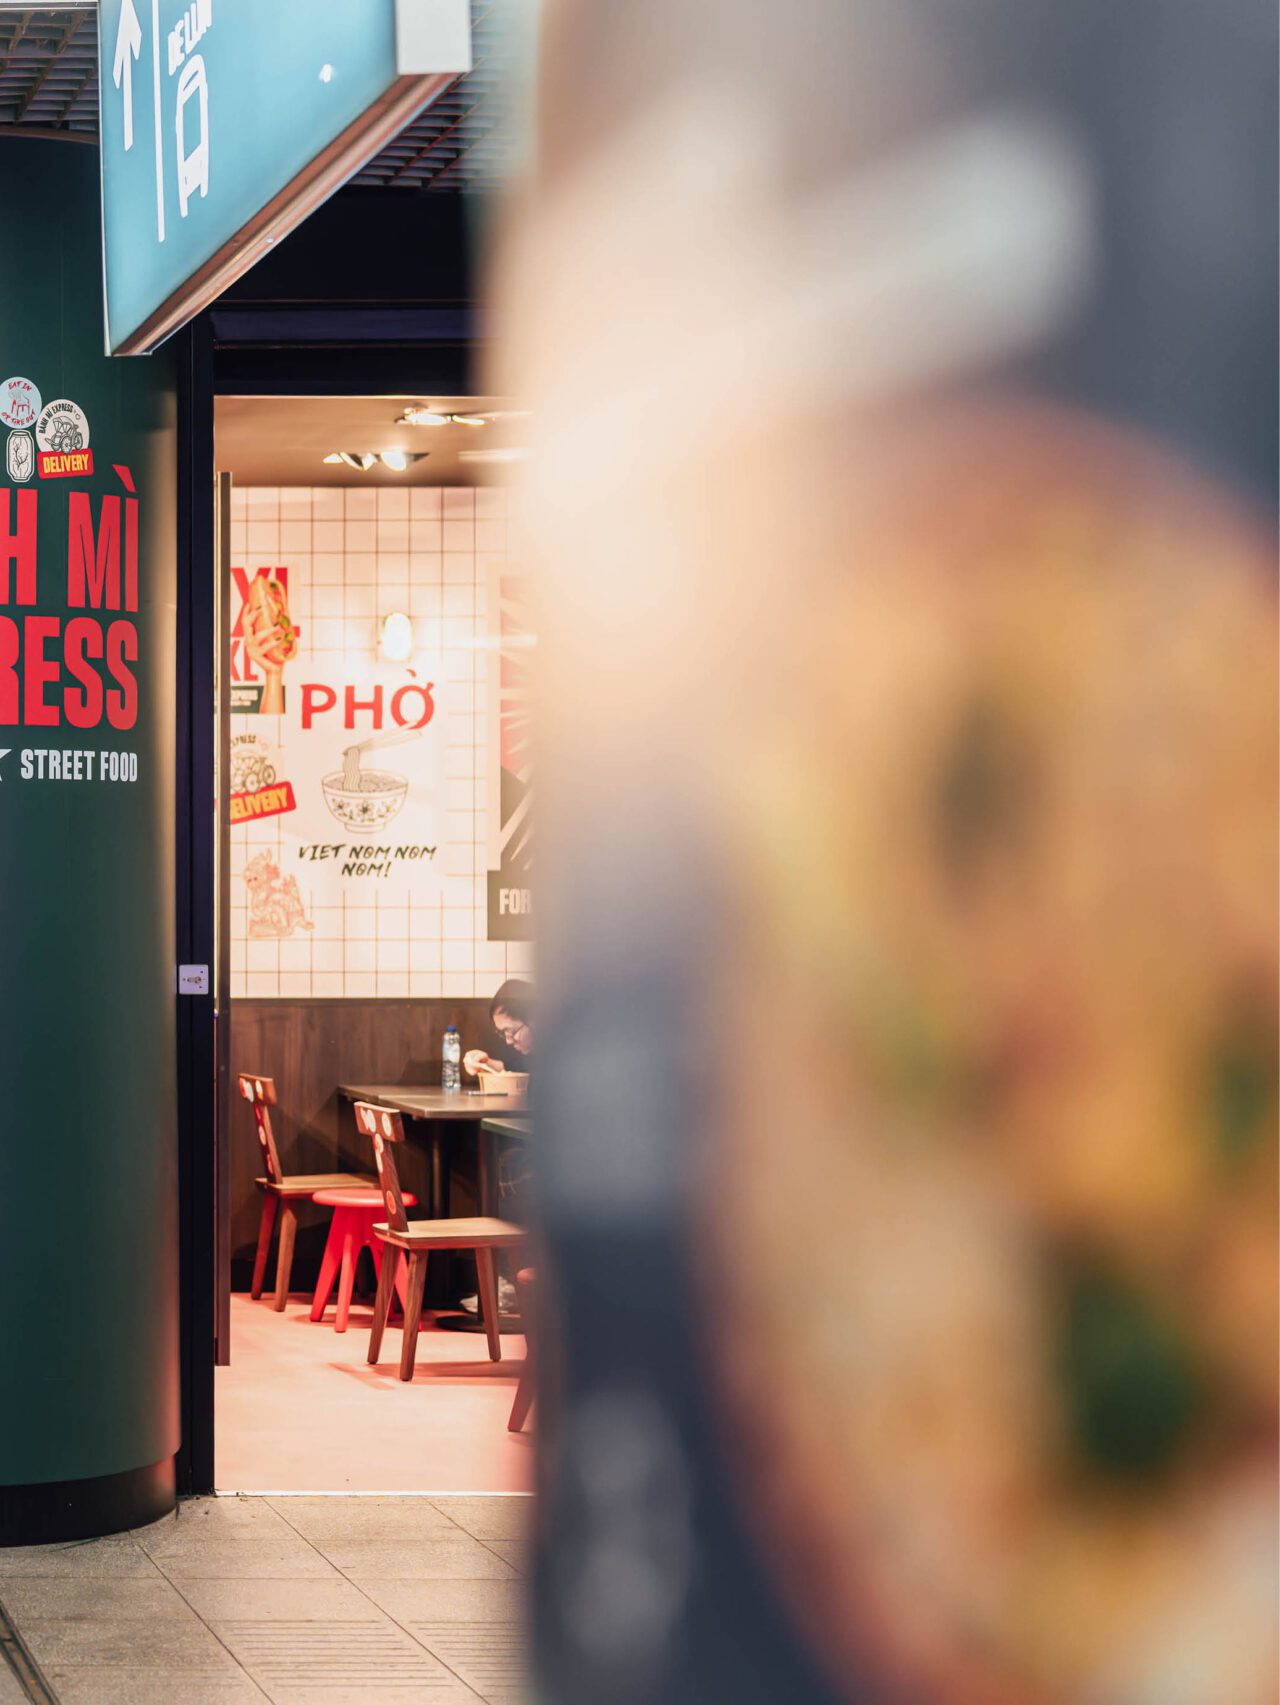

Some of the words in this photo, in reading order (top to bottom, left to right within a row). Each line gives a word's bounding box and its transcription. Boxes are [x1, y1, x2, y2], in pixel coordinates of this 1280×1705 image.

[8, 381, 22, 390] EAT
[22, 383, 32, 391] IN
[52, 403, 74, 413] EXPRESS
[42, 454, 89, 473] DELIVERY
[67, 464, 139, 612] MÌ
[20, 749, 95, 781] STREET
[100, 752, 139, 782] FOOD
[230, 787, 288, 820] ELIVERY
[298, 843, 346, 861] VIET
[349, 845, 390, 861] NOM
[394, 845, 437, 861] NOM
[341, 861, 392, 878] NOM!
